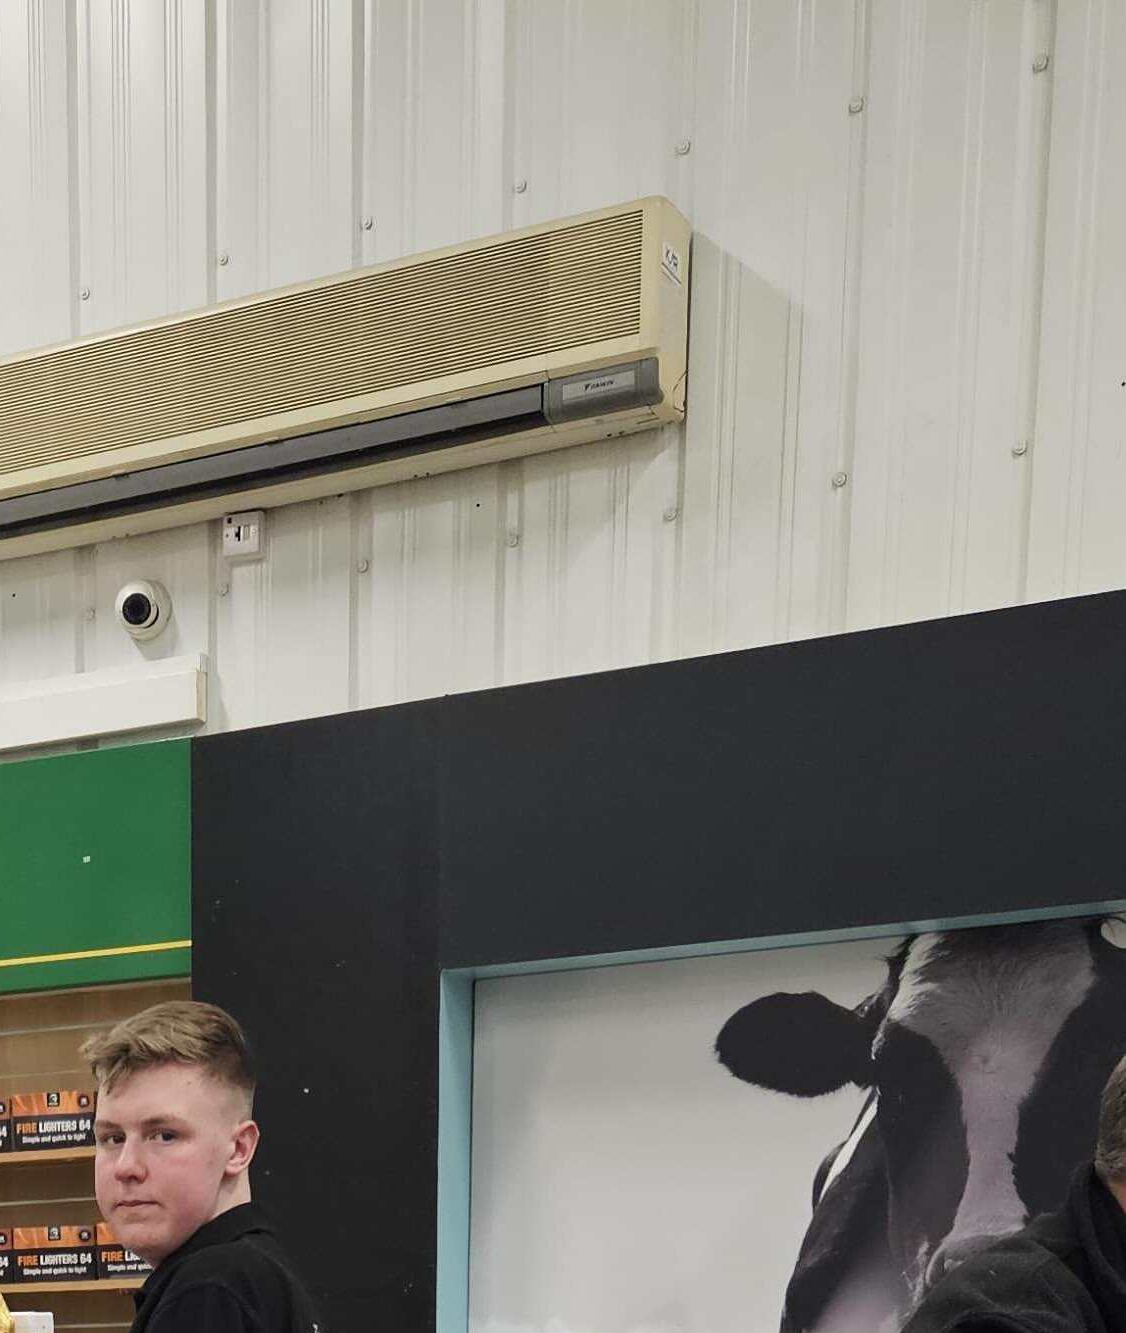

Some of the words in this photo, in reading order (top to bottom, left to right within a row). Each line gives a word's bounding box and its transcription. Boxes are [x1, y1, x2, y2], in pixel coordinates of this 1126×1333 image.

[17, 1122, 37, 1134] FIRE
[39, 1120, 77, 1133] LIGHTERS
[79, 1119, 91, 1130] 64
[18, 1256, 38, 1266] FIRE
[40, 1254, 78, 1266] LIGHTERS
[80, 1253, 92, 1265] 64
[101, 1251, 123, 1262] FIRE
